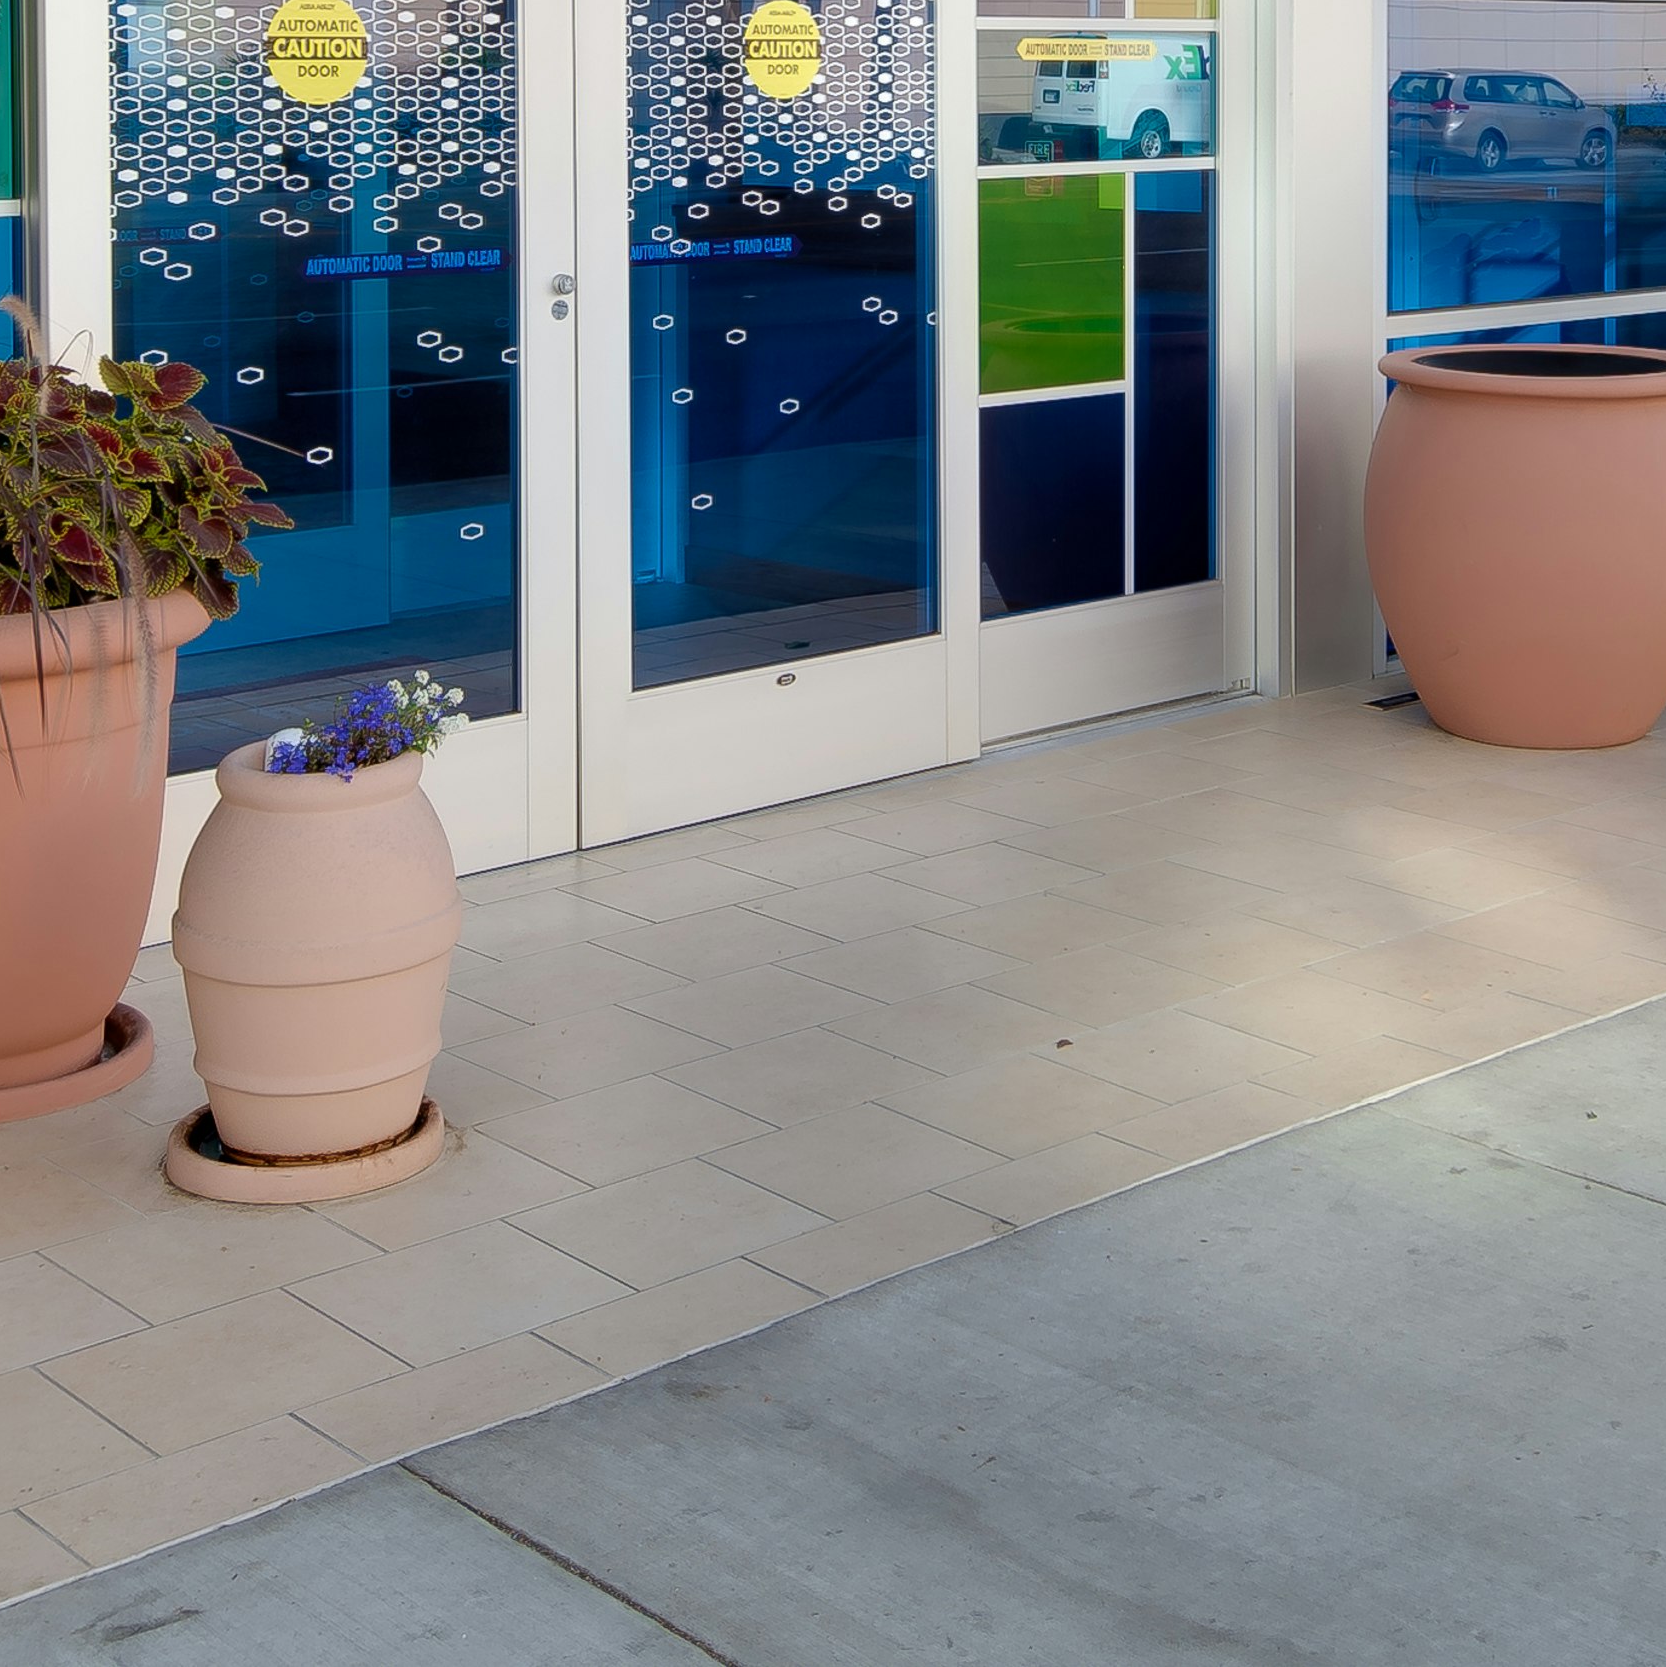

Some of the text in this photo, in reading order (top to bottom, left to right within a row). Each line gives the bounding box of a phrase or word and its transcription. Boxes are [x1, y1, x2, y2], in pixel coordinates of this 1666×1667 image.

[277, 19, 359, 32] AUTOMATIC
[752, 23, 814, 35] AUTOMATIC
[273, 37, 363, 58] CAUTION
[749, 40, 818, 58] CAUTION
[1025, 43, 1067, 56] AUTOMATIC
[1068, 43, 1088, 56] DOOR
[1104, 43, 1128, 56] STAND
[1128, 43, 1151, 56] CLEAR
[297, 64, 340, 78] DOOR
[767, 64, 800, 76] DOOR
[733, 238, 763, 254] STAND
[764, 237, 793, 252] CLEAR
[306, 256, 371, 276] AUTOMATIC
[372, 254, 403, 272] DOOR
[430, 251, 466, 269] STAND
[467, 248, 502, 267] CLEAR
